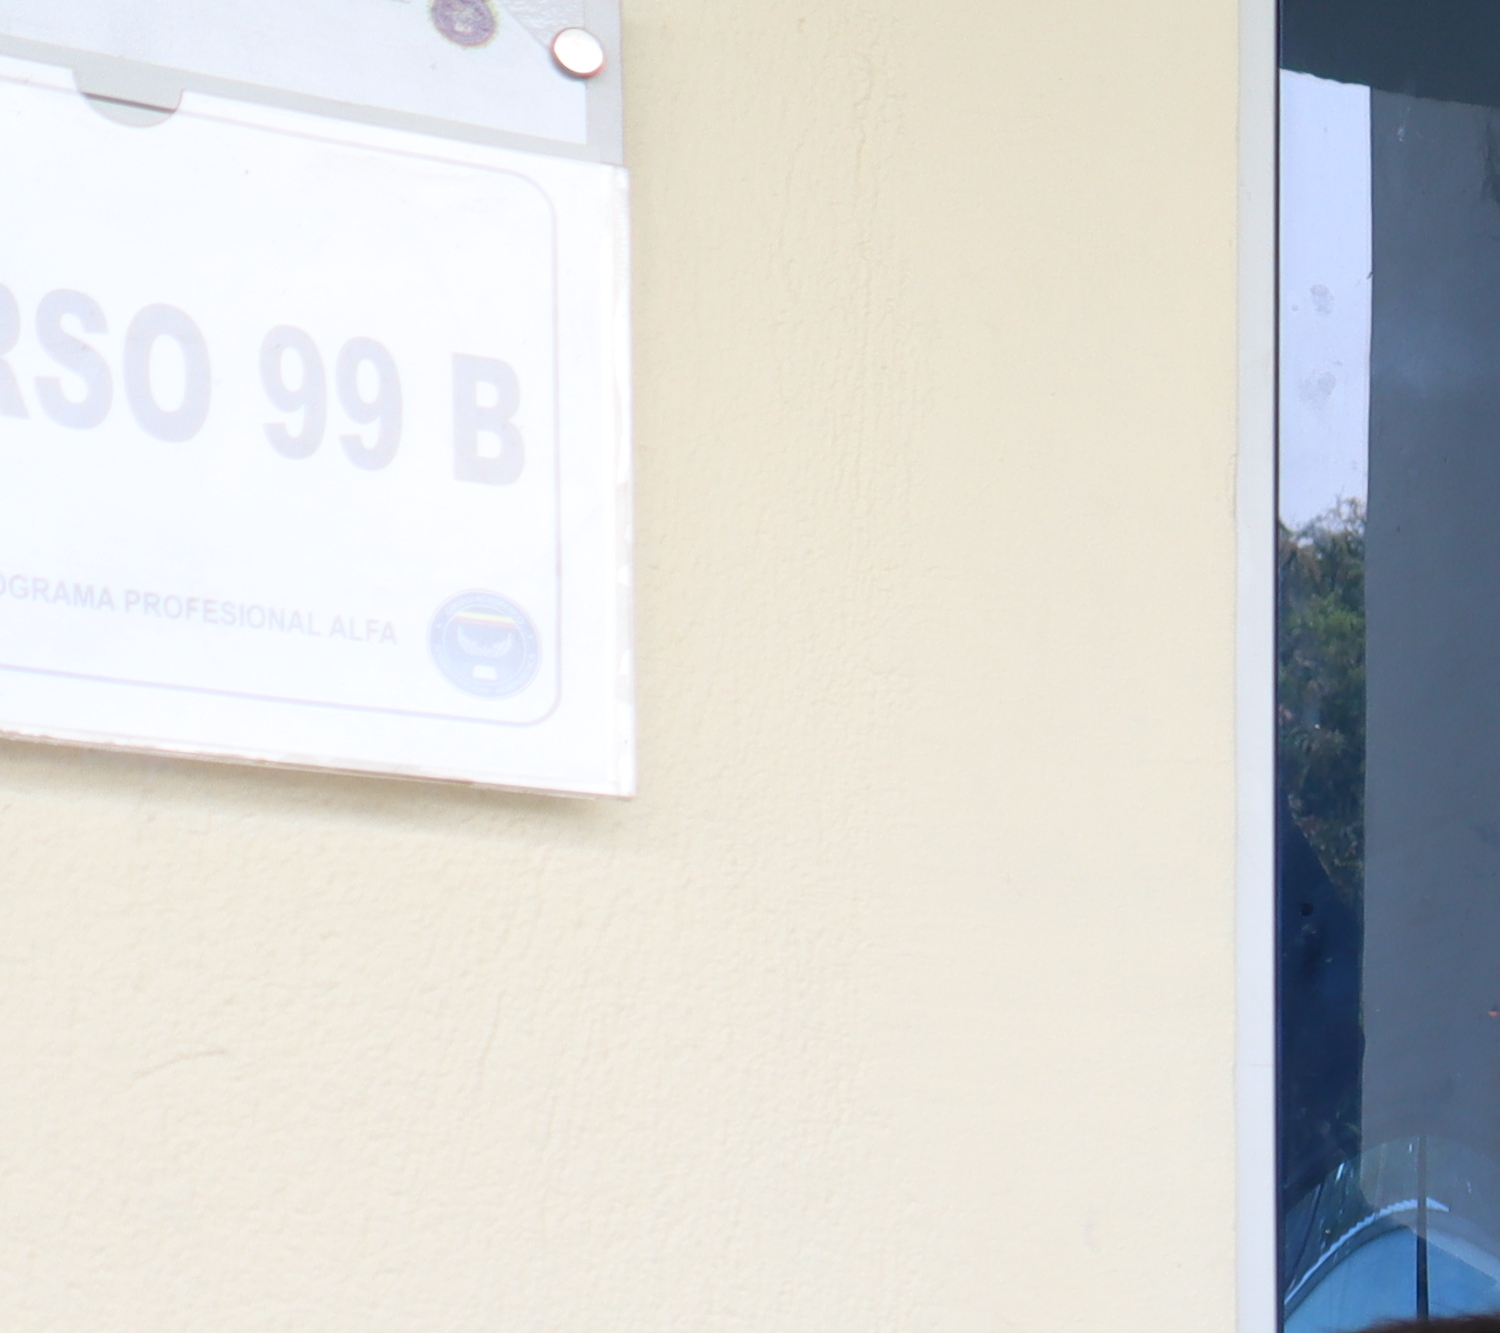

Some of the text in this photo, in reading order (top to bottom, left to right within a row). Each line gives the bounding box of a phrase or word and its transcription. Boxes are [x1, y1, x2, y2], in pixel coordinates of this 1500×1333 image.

[258, 324, 403, 471] 99
[451, 351, 526, 487] B
[125, 588, 322, 637] PROFESIONAL
[329, 614, 399, 646] ALFA
